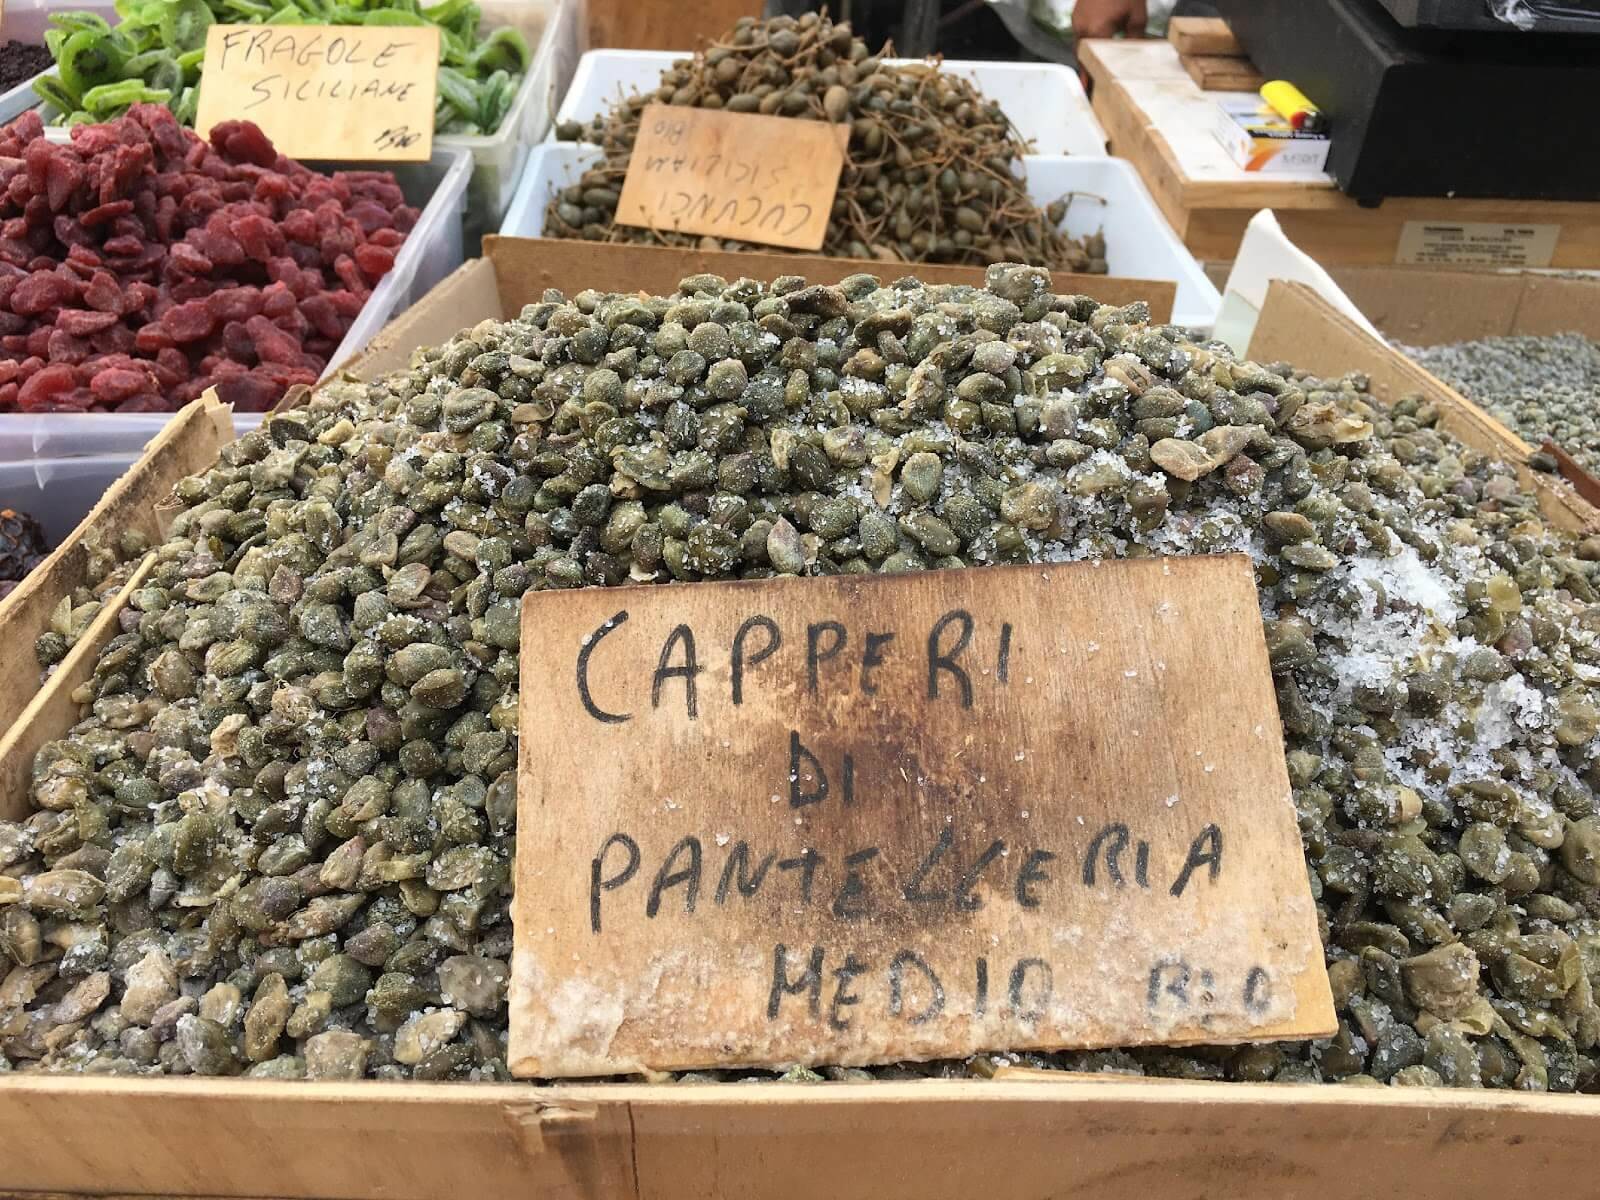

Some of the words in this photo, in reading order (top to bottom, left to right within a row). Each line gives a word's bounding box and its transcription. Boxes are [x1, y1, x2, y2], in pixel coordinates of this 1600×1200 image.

[221, 28, 415, 70] FRAGOLE
[243, 74, 417, 110] SICILIANE
[657, 191, 813, 237] CUCUNCI
[576, 608, 1012, 724] CAPPERI
[789, 730, 854, 808] DI
[590, 822, 1223, 933] PANTELLERIA
[767, 943, 1054, 1031] MEDIO
